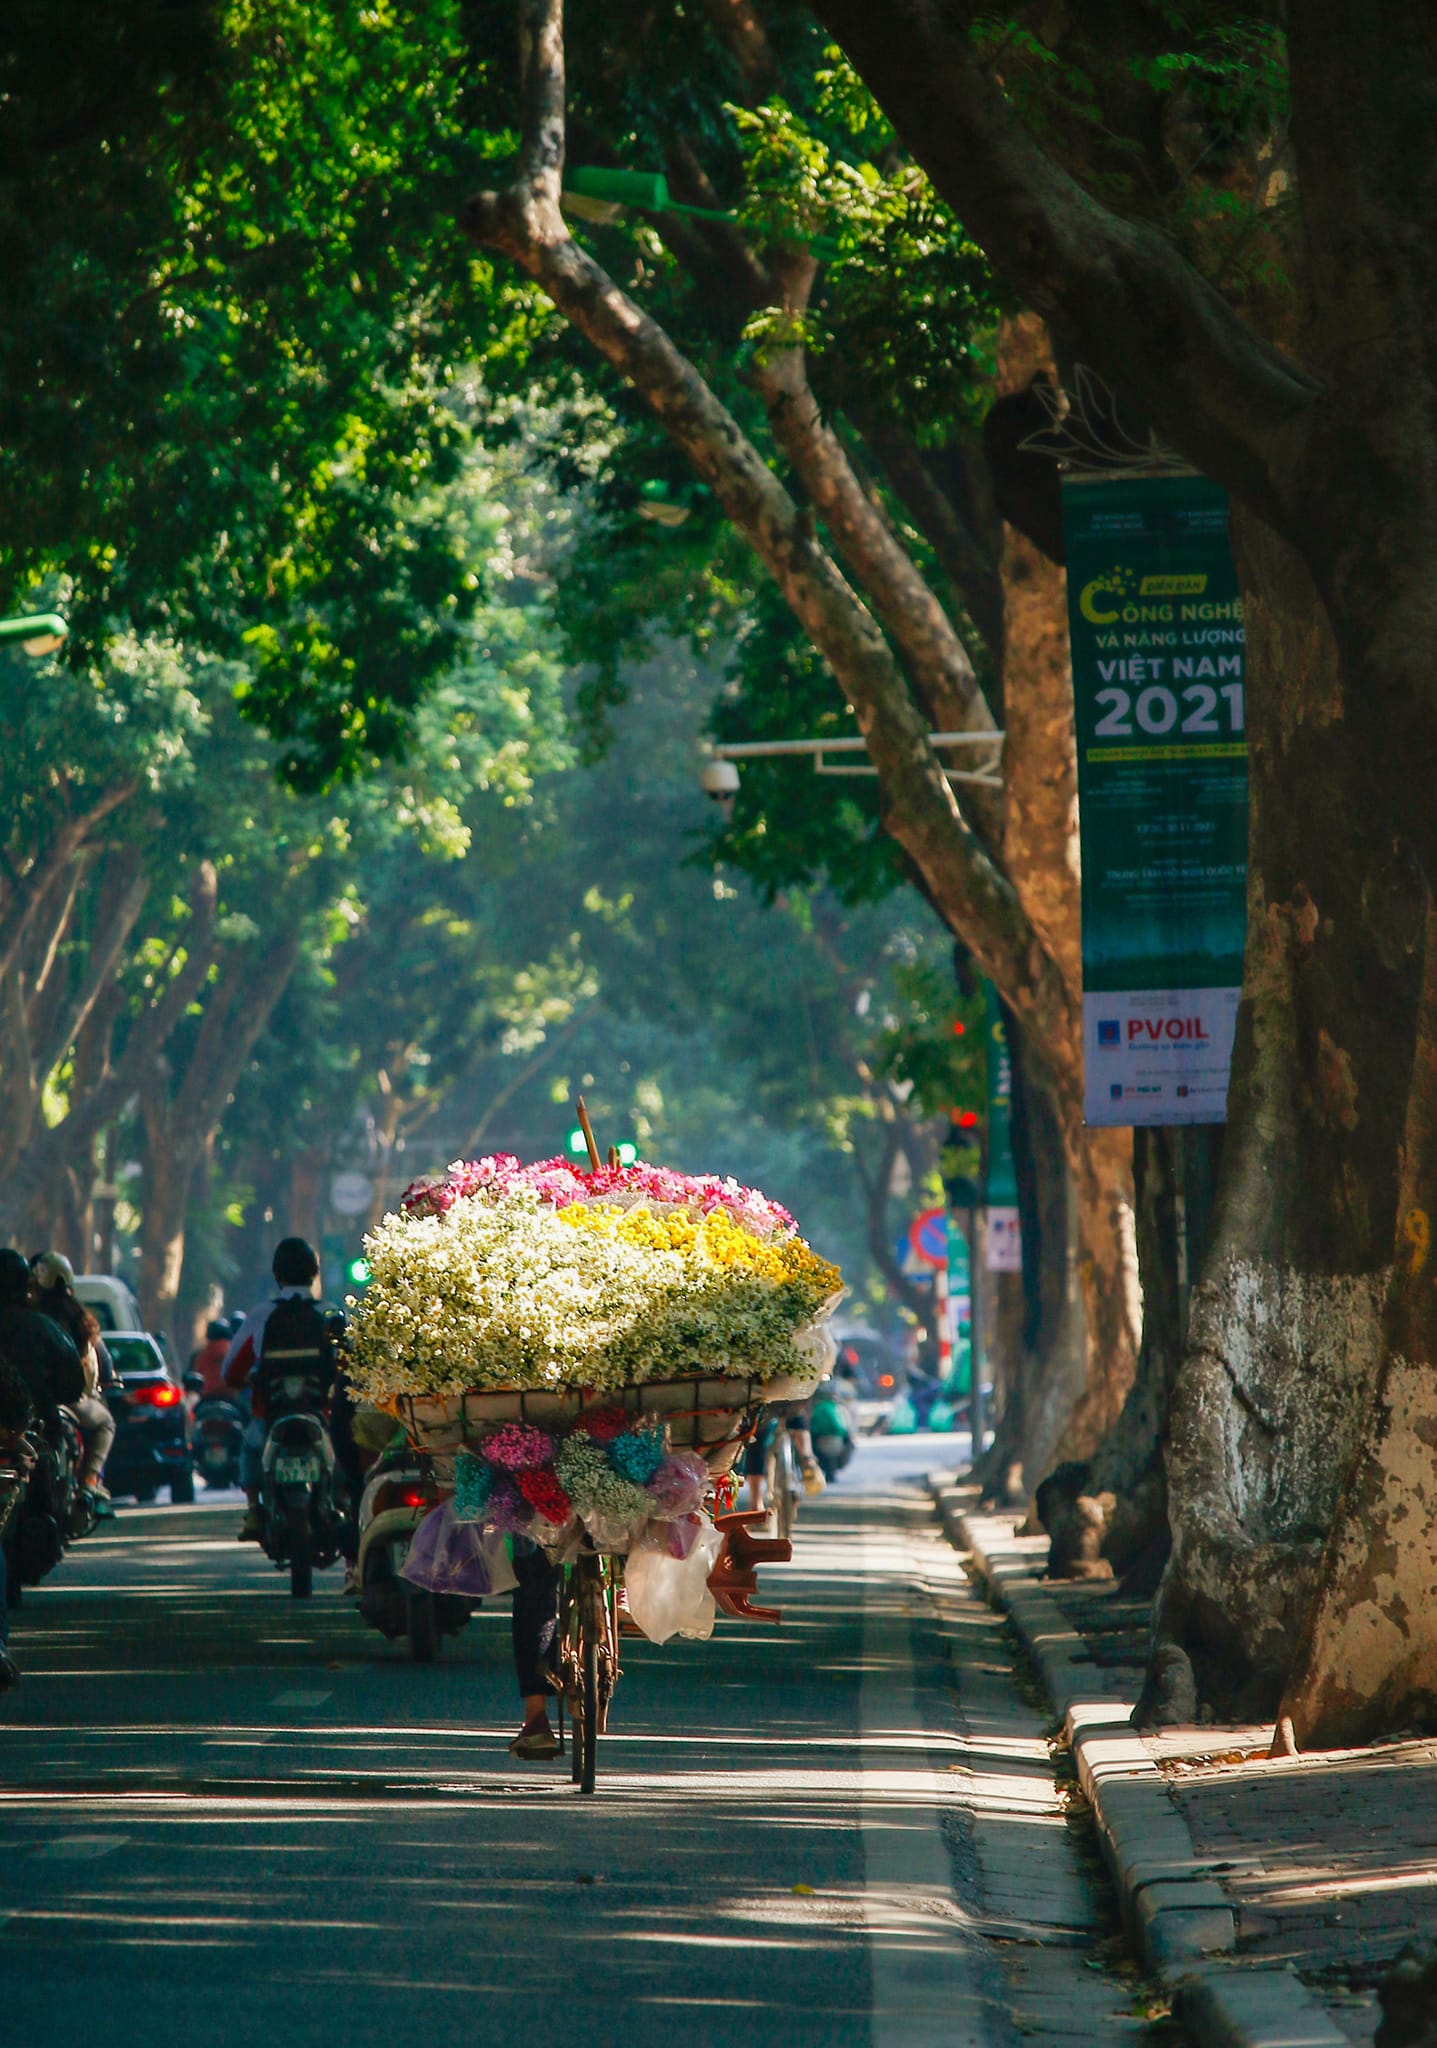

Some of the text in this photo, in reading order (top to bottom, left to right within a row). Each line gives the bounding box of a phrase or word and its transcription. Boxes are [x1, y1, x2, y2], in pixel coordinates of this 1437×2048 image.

[1080, 578, 1244, 624] CÔNG NGHỆ
[1096, 630, 1119, 648] VÀ
[1182, 627, 1246, 648] LƯỢNG
[1097, 653, 1241, 685] VIỆT NAM
[1095, 683, 1244, 736] 2021
[1128, 1017, 1210, 1040] PVOIL
